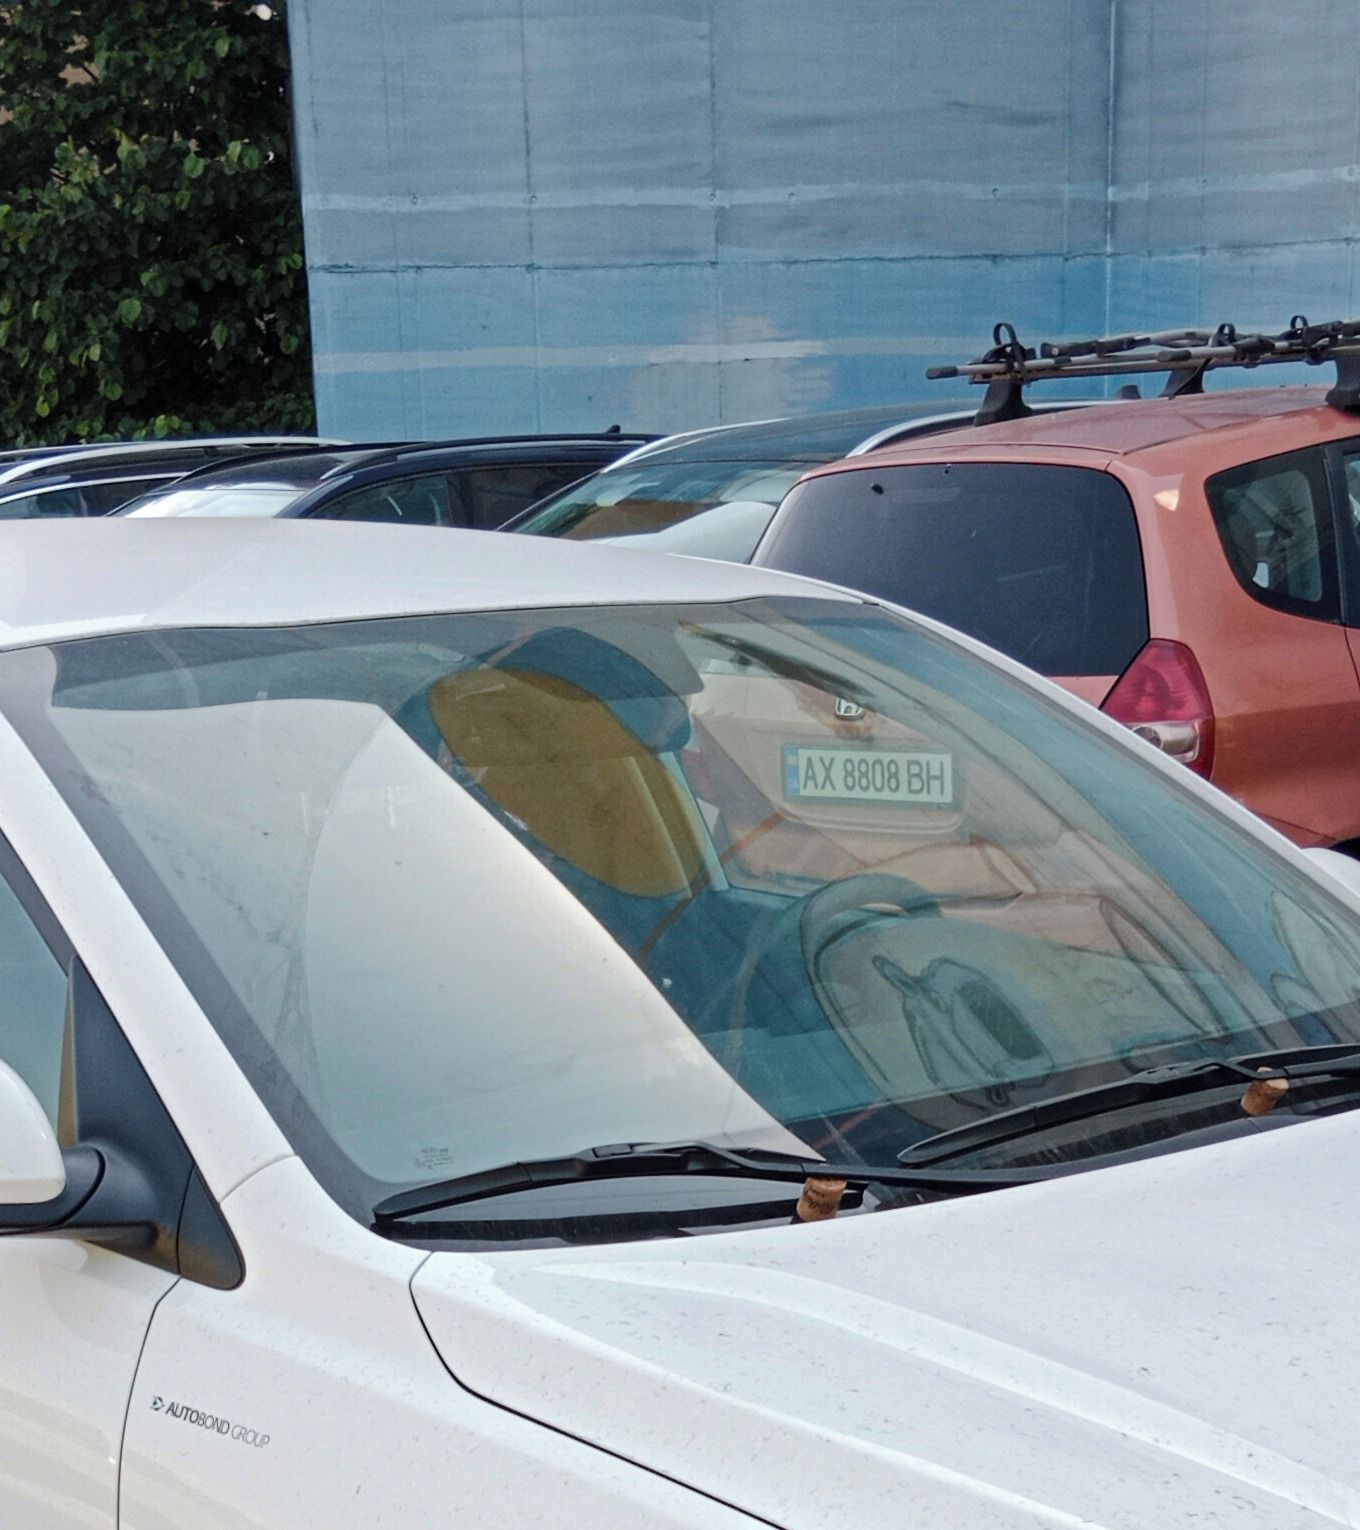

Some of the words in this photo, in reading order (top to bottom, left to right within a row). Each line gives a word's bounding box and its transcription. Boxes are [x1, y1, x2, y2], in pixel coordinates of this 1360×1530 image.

[802, 756, 836, 792] AX
[843, 758, 900, 793] 8808
[906, 759, 944, 796] BH
[165, 1401, 230, 1435] AUTOBOND
[231, 1424, 271, 1448] GROUP
